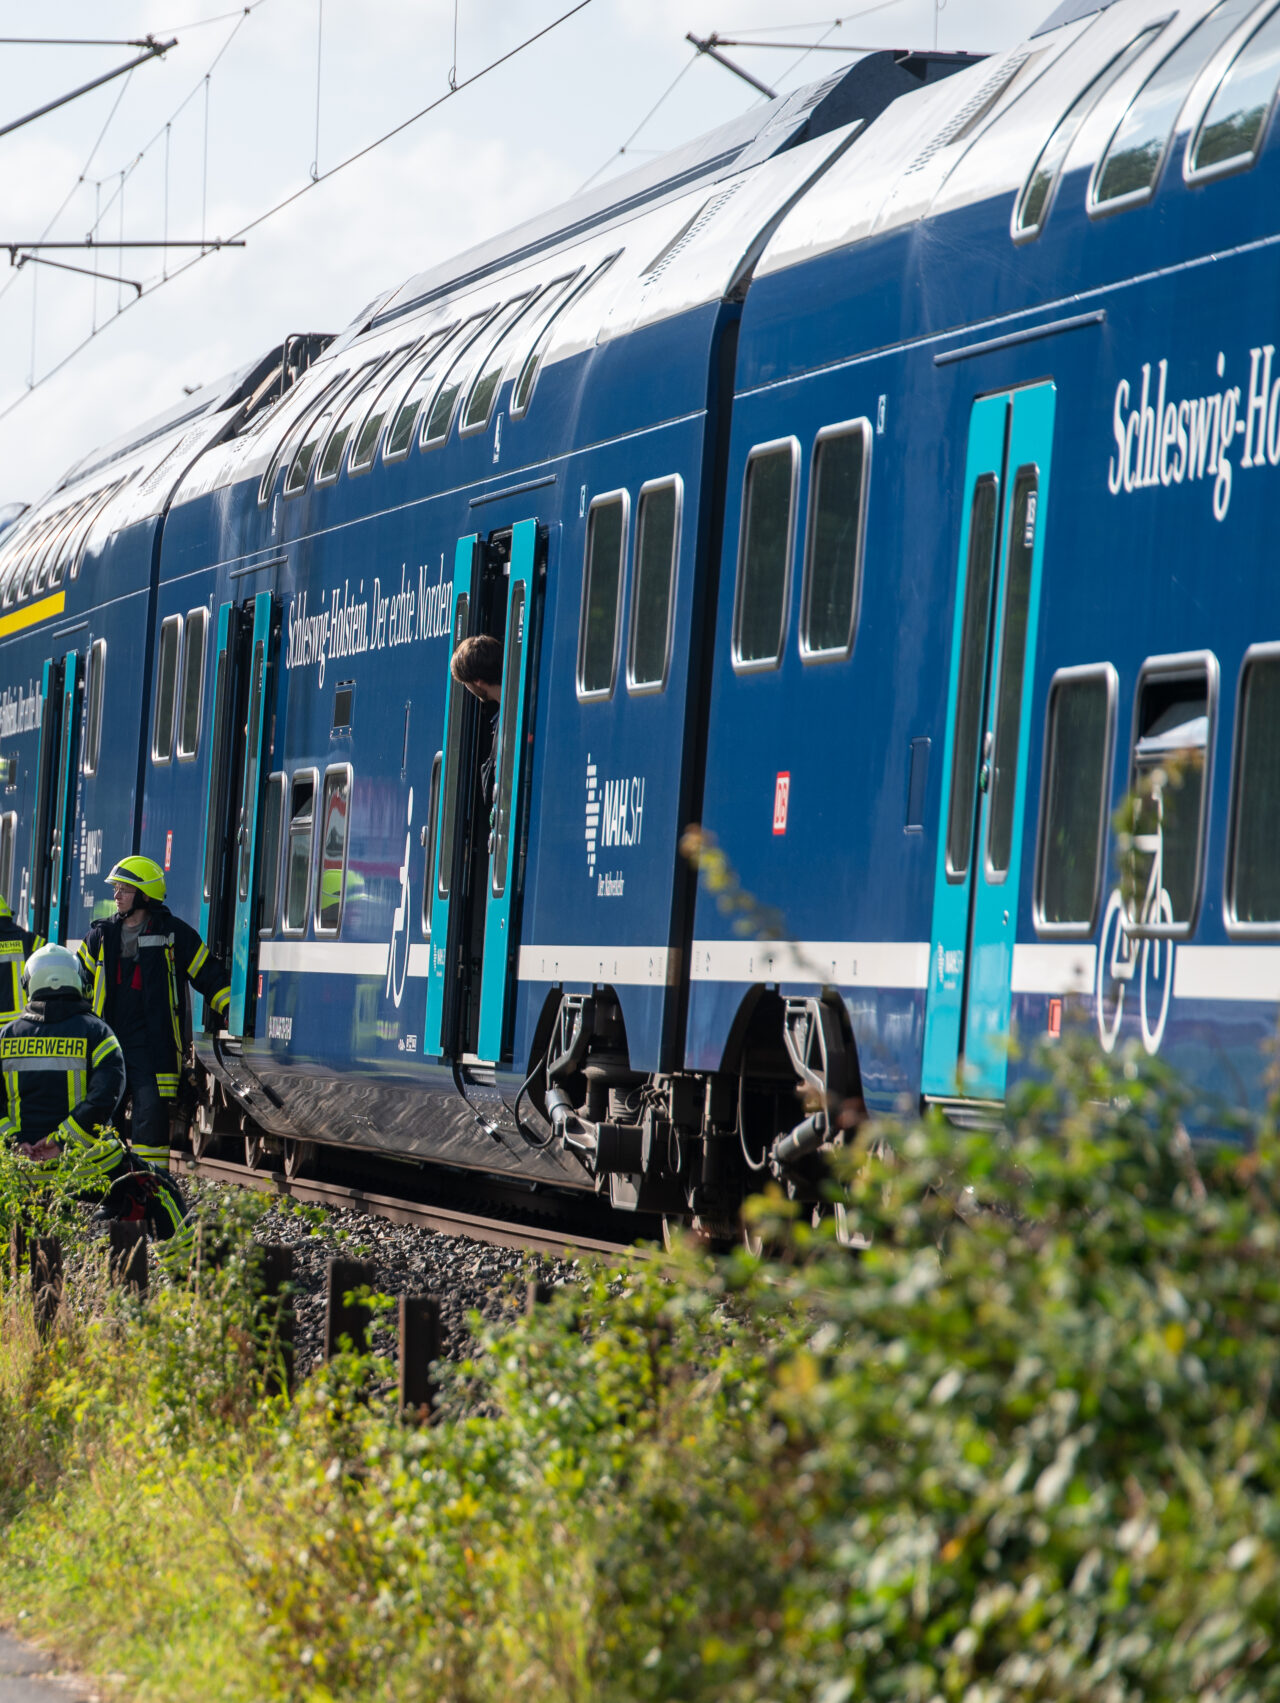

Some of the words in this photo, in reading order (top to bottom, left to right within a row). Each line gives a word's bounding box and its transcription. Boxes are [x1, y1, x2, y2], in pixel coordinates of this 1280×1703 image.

[285, 577, 369, 689] Schleswig-Holstein.
[370, 577, 390, 650] Der
[389, 562, 416, 648] echte
[414, 552, 453, 641] Norden
[601, 776, 646, 847] NAH.SH
[2, 1038, 85, 1057] FEUERWEHR
